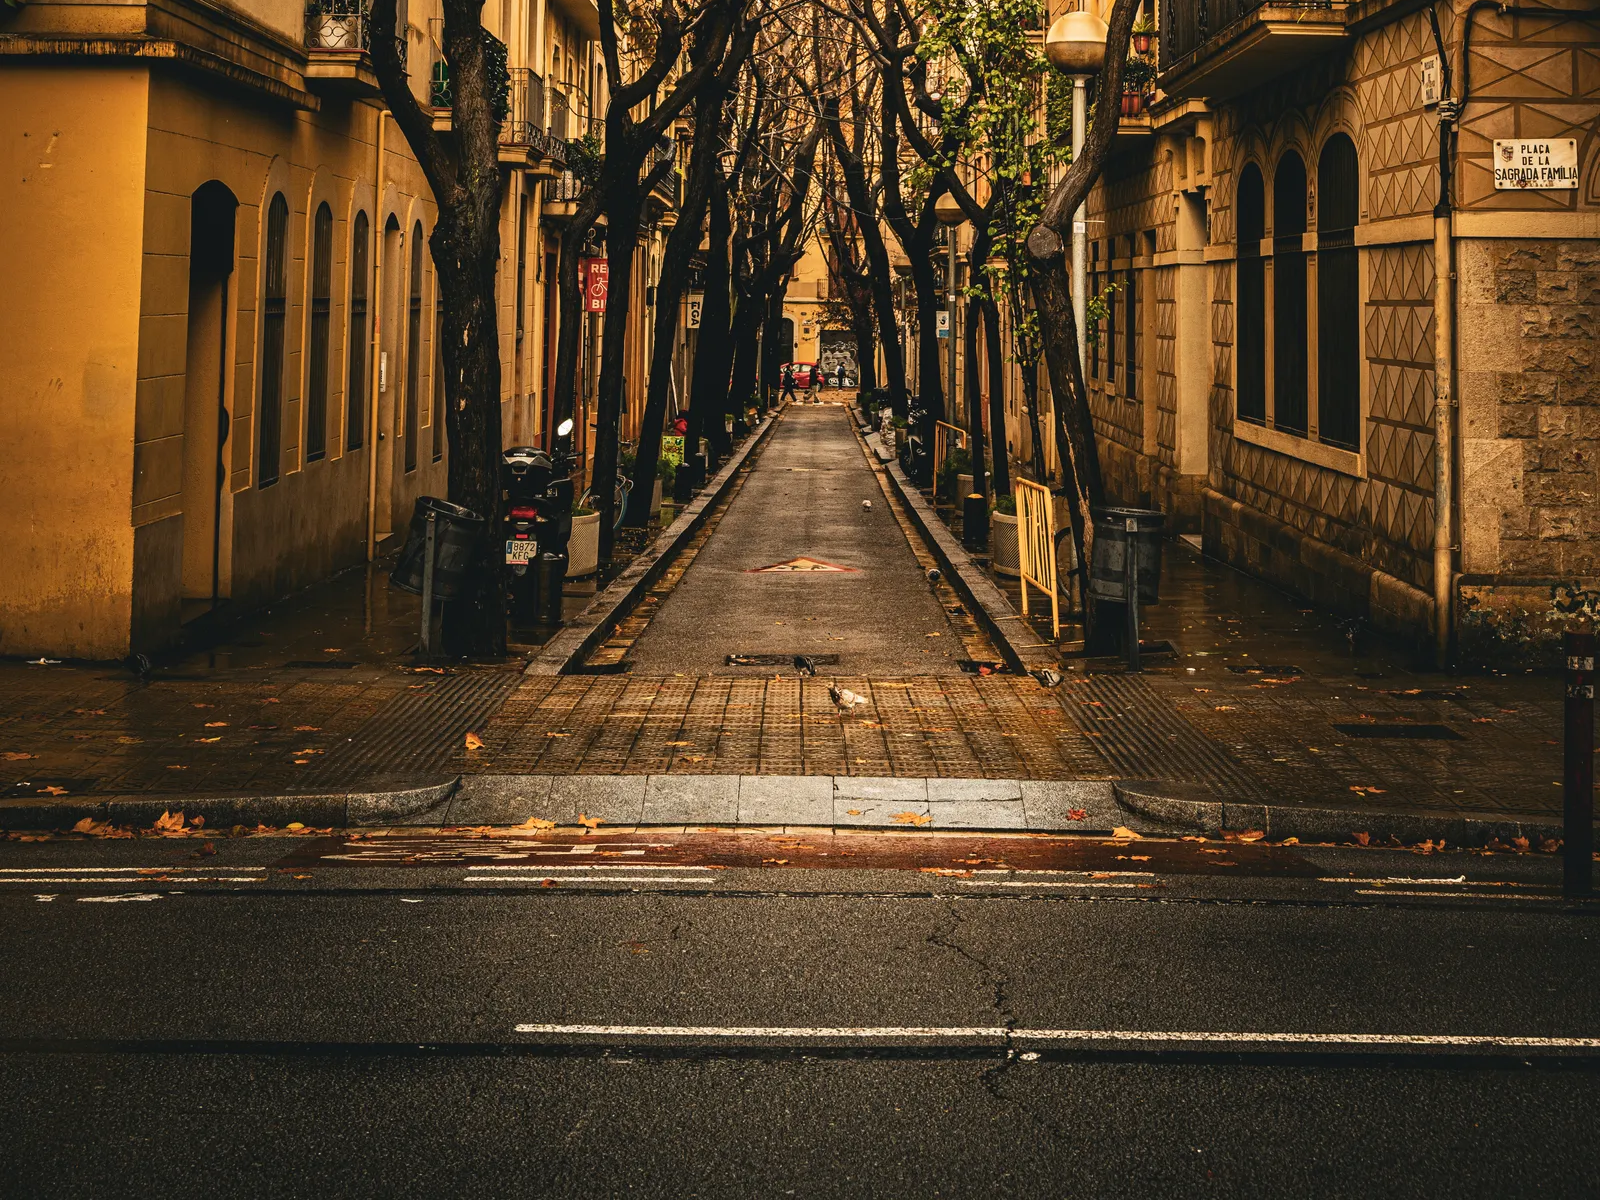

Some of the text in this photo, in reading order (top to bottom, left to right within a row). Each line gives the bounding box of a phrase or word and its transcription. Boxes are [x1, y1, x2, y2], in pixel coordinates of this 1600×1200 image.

[1521, 144, 1550, 154] PLAÇA
[1522, 156, 1550, 165] DE LA
[1495, 166, 1578, 180] SAGRADA FAMÍLIA
[591, 264, 607, 273] RE
[592, 299, 604, 309] BI
[513, 543, 536, 551] 8872
[512, 551, 529, 560] KFG
